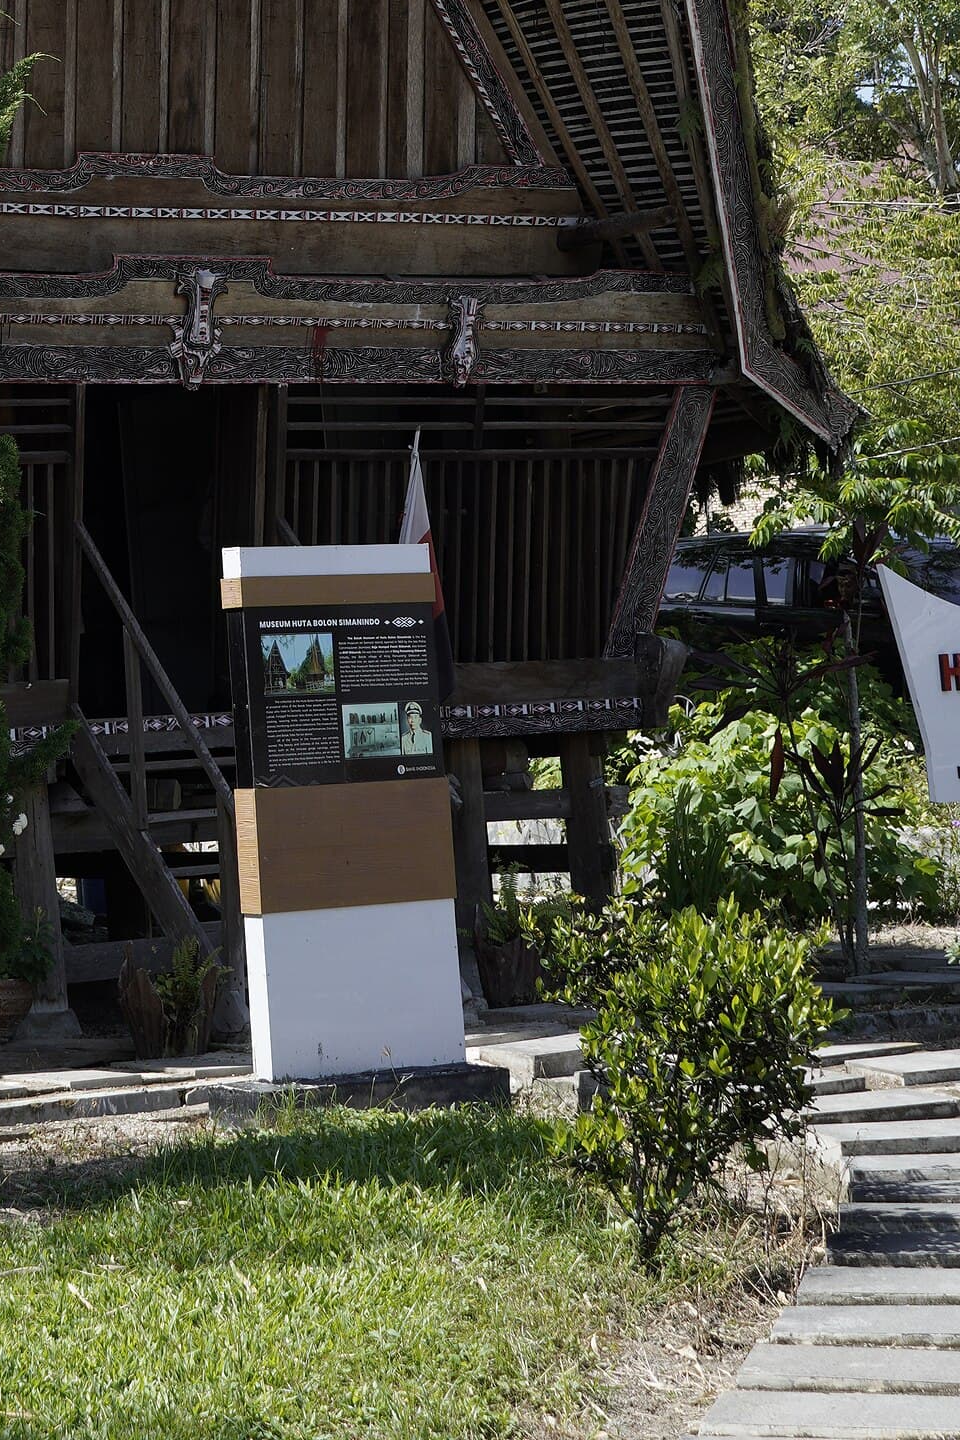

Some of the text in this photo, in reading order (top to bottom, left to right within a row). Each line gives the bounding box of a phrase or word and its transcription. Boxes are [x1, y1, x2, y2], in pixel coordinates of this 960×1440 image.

[259, 620, 291, 628] MUSEUM
[313, 619, 338, 627] BOLON
[339, 618, 380, 626] SIMANINDO
